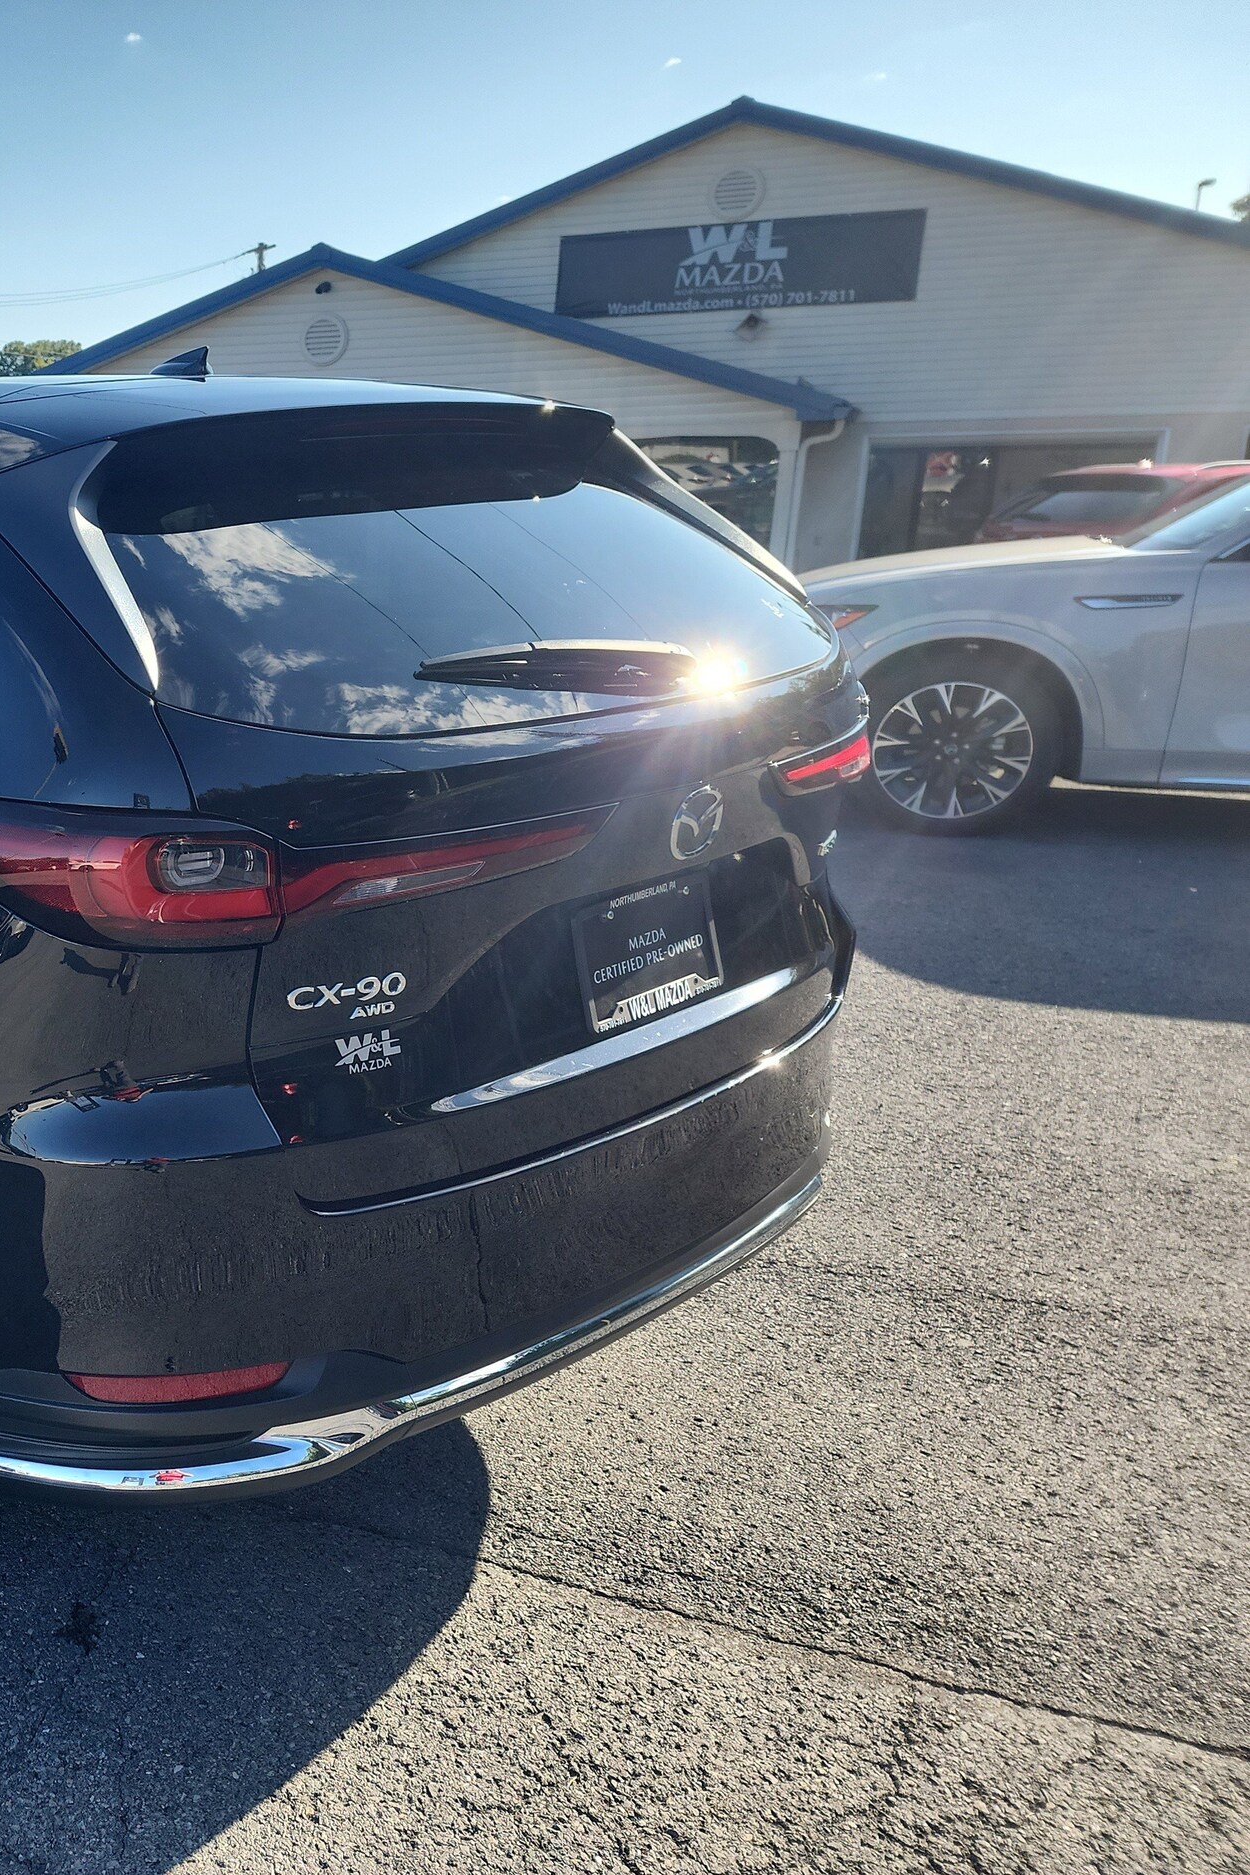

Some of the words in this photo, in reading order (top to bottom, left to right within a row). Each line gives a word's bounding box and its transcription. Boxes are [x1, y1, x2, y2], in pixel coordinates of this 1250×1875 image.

[679, 222, 788, 267] W&L
[674, 261, 784, 289] MAZDA
[609, 883, 668, 909] NORTHUMBERLAND,
[669, 881, 677, 890] PA
[629, 928, 667, 951] MAZDA
[594, 956, 644, 984] CERTIFIED
[646, 934, 704, 966] PRE-OWNED
[287, 972, 406, 1010] CX-90
[629, 992, 657, 1020] W&L
[655, 979, 692, 1011] MAZDA
[350, 1001, 395, 1019] AWD
[335, 1029, 401, 1066] W&L
[350, 1057, 392, 1074] MAZDA
